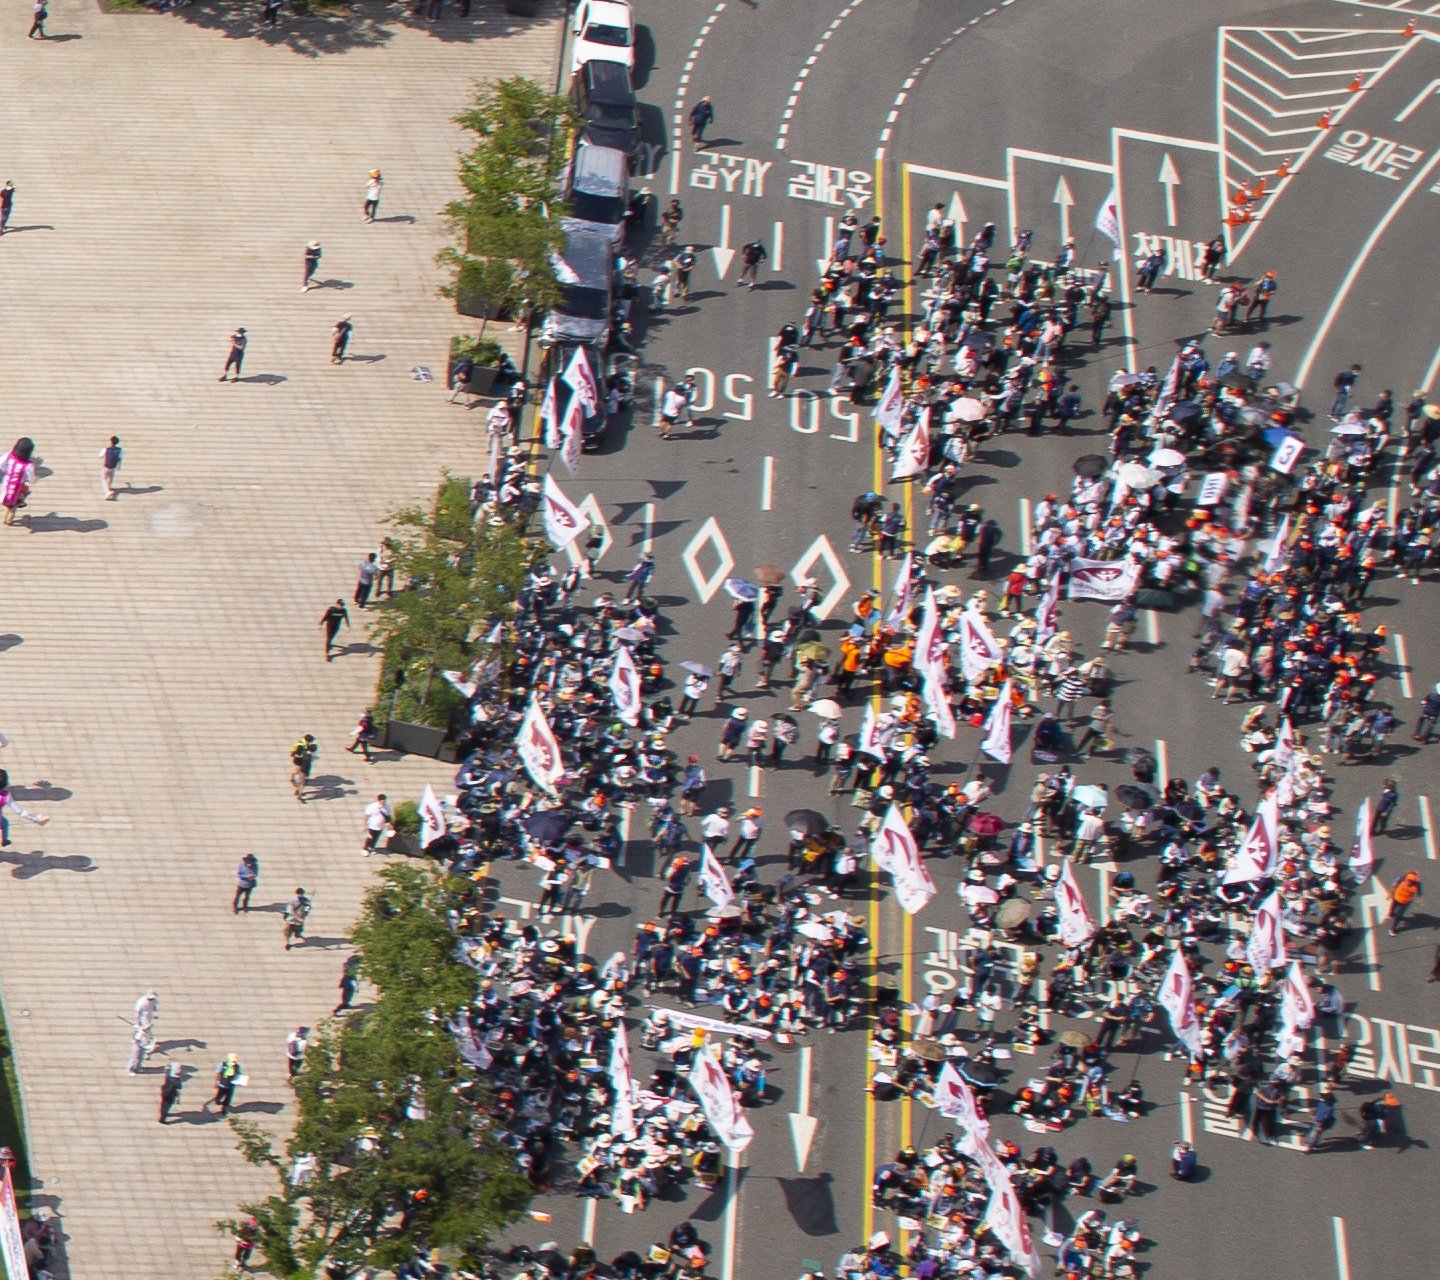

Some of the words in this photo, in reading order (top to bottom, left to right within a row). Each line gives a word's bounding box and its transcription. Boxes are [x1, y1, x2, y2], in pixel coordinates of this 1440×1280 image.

[689, 151, 772, 197] 서소문
[1324, 130, 1425, 180] 을지로
[787, 160, 873, 209] 숭례문
[790, 389, 861, 444] 50
